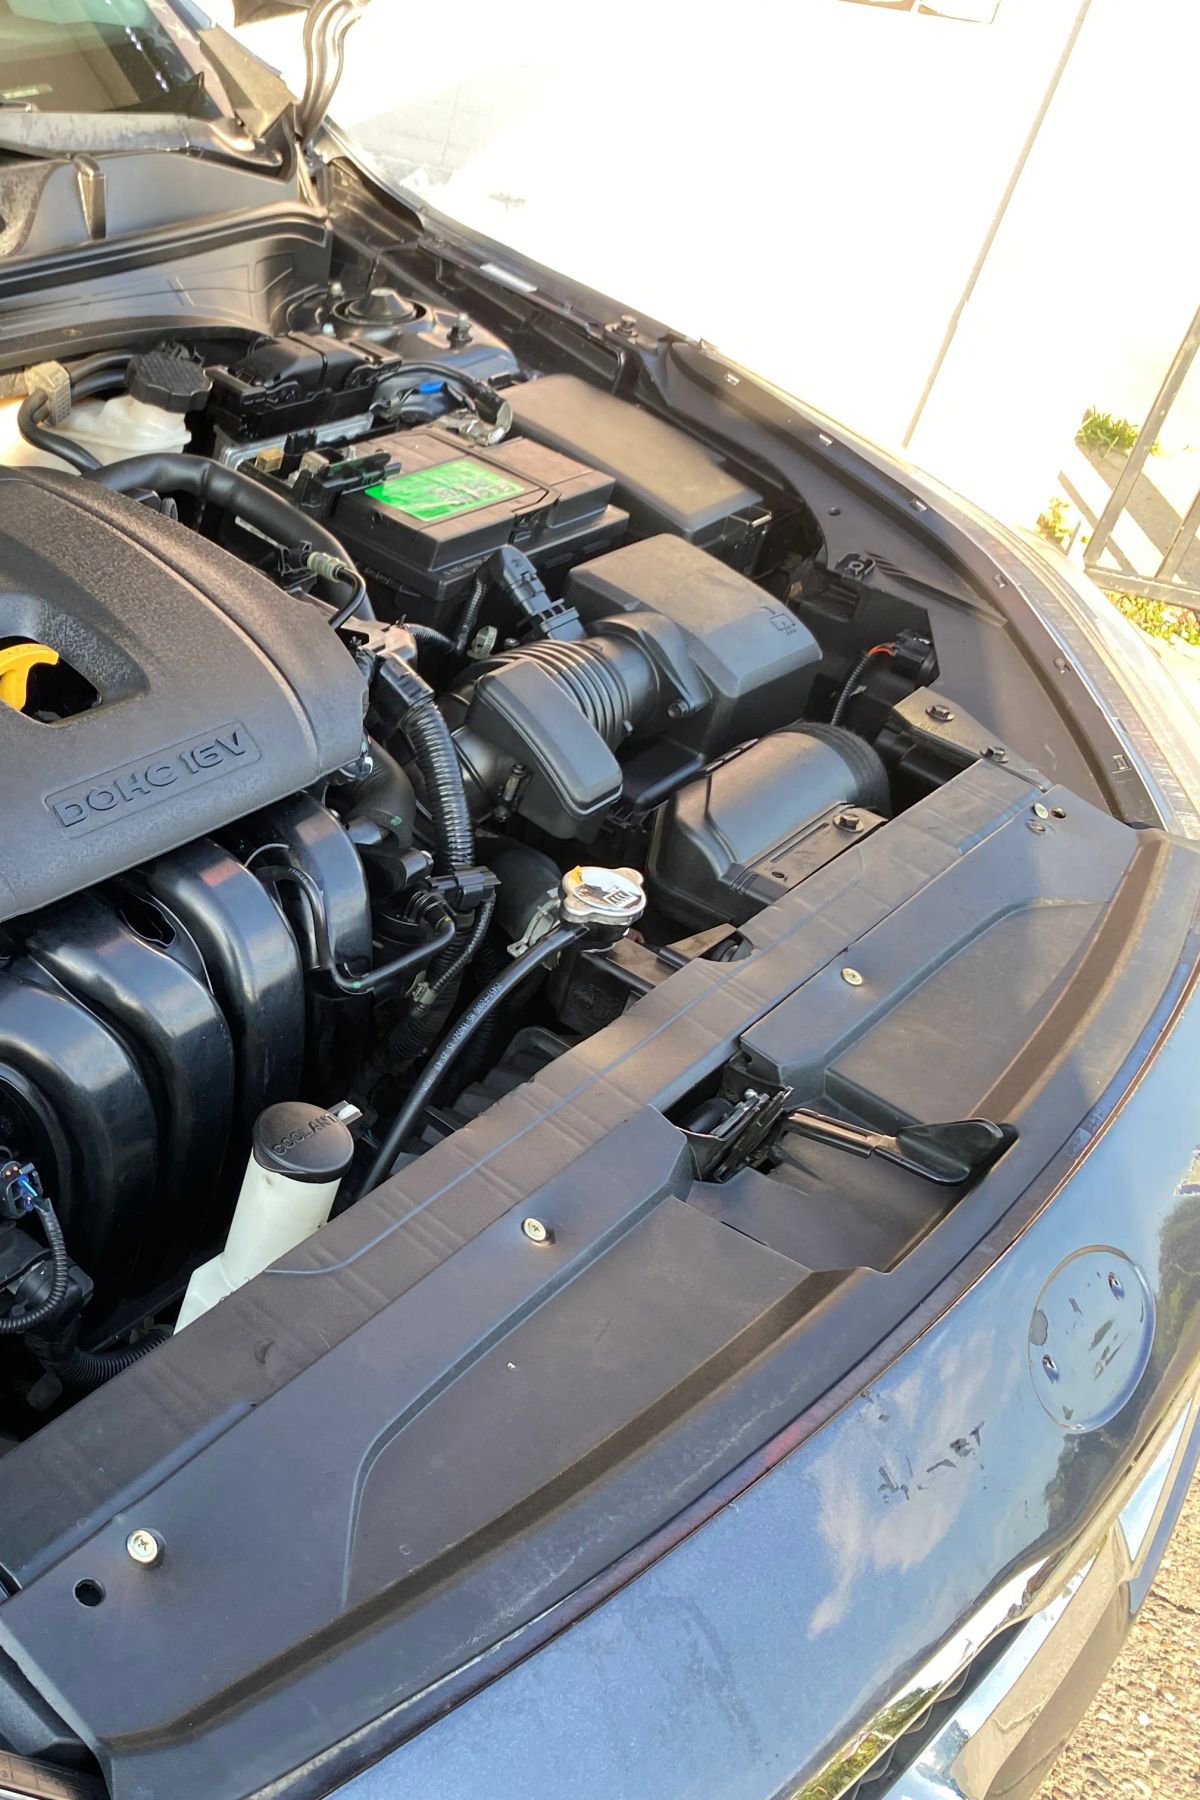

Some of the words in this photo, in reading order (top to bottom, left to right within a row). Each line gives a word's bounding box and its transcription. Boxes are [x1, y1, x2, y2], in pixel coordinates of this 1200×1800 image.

[52, 760, 179, 828] DOHC
[179, 730, 246, 774] 16V
[272, 1113, 338, 1156] COOLANT
